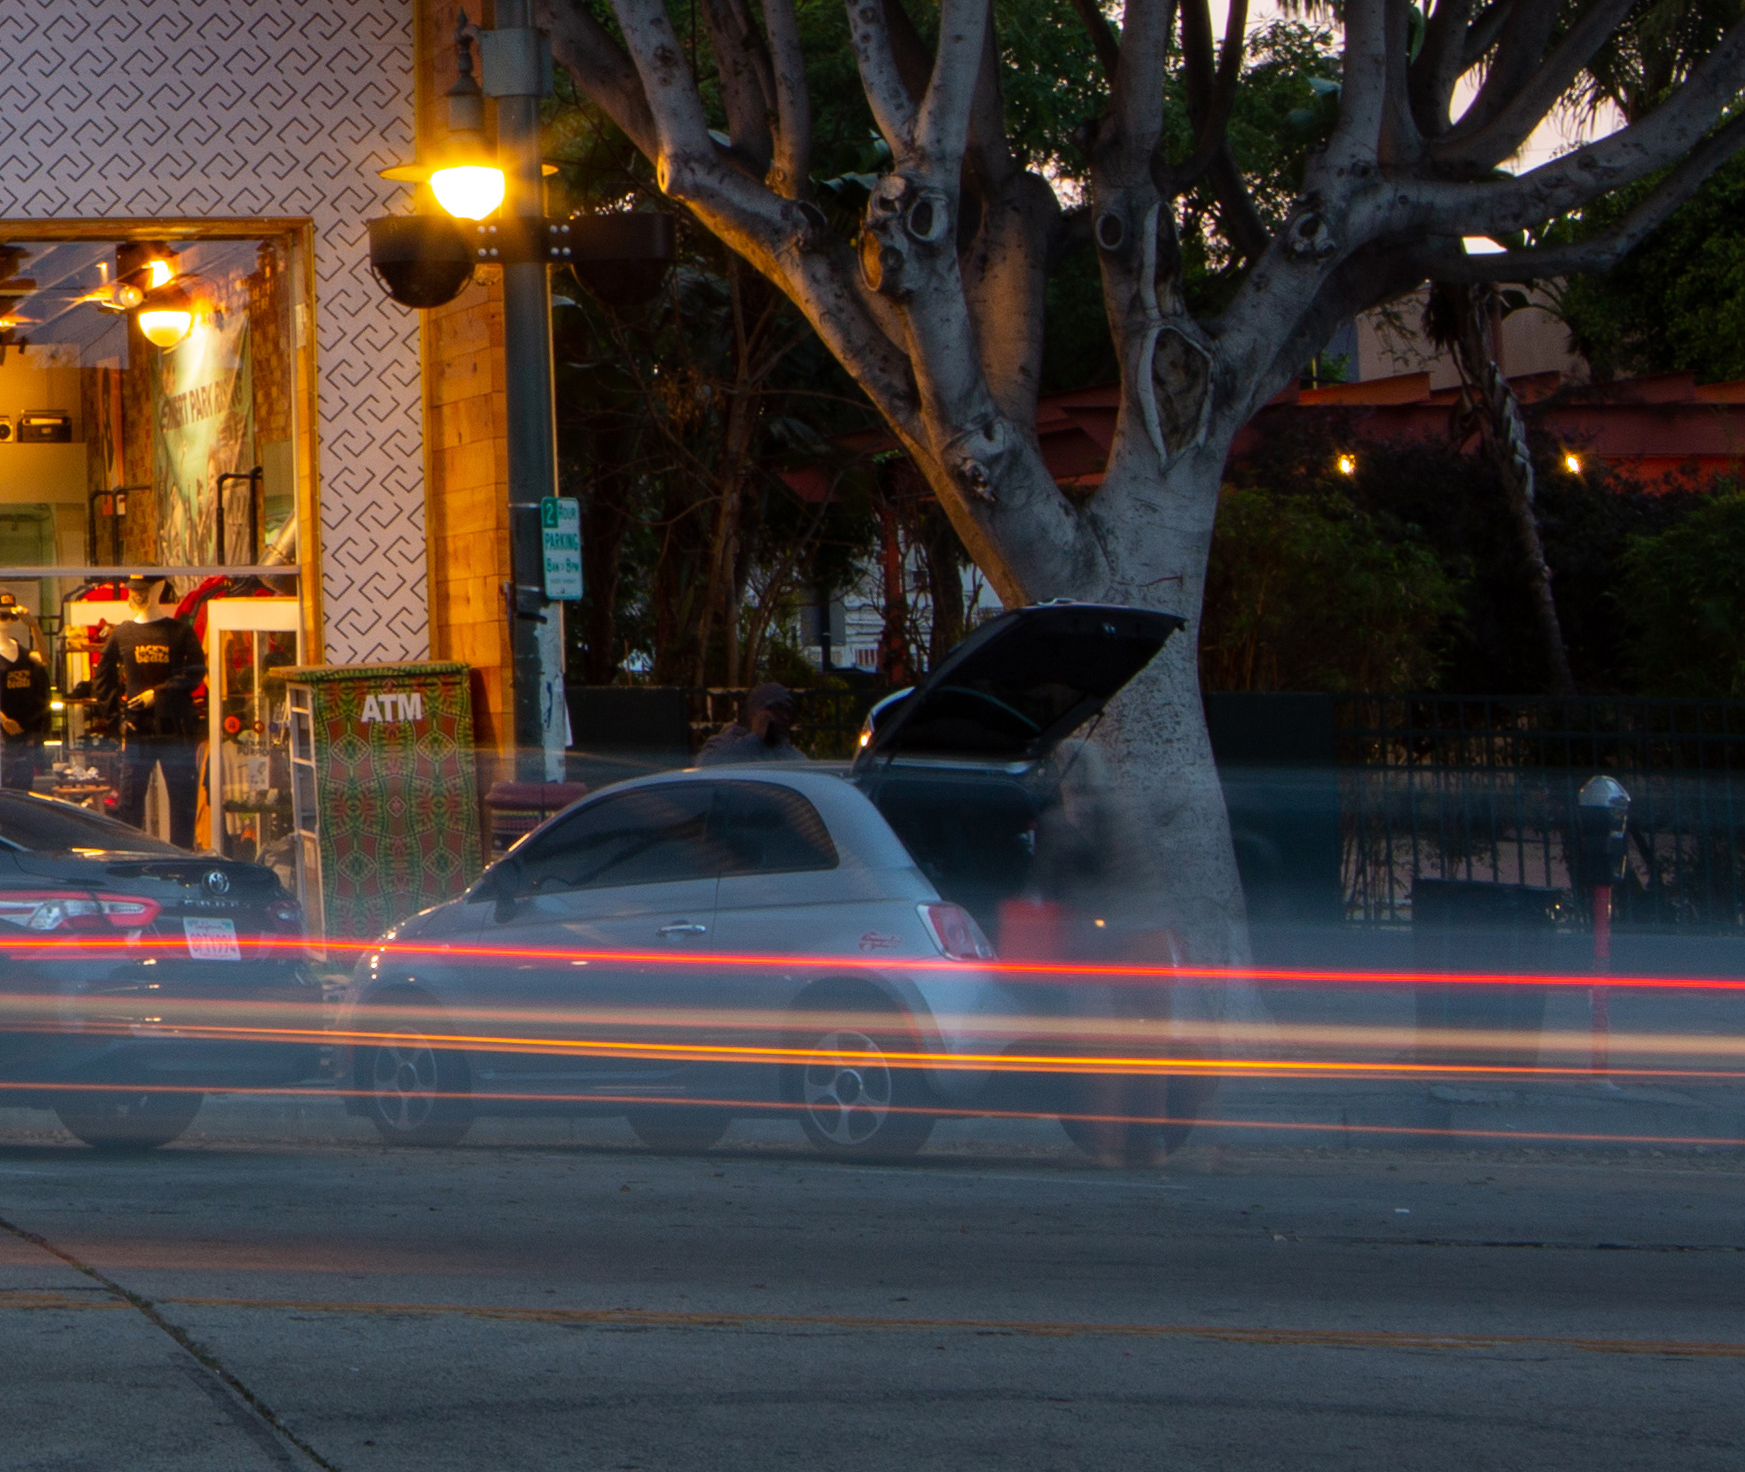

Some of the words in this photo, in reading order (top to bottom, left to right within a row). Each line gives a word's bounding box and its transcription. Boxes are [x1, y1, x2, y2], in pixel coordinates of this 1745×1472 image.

[545, 503, 555, 525] 2
[558, 506, 578, 520] HOUR
[544, 533, 580, 551] PARKING
[360, 691, 423, 724] ATM
